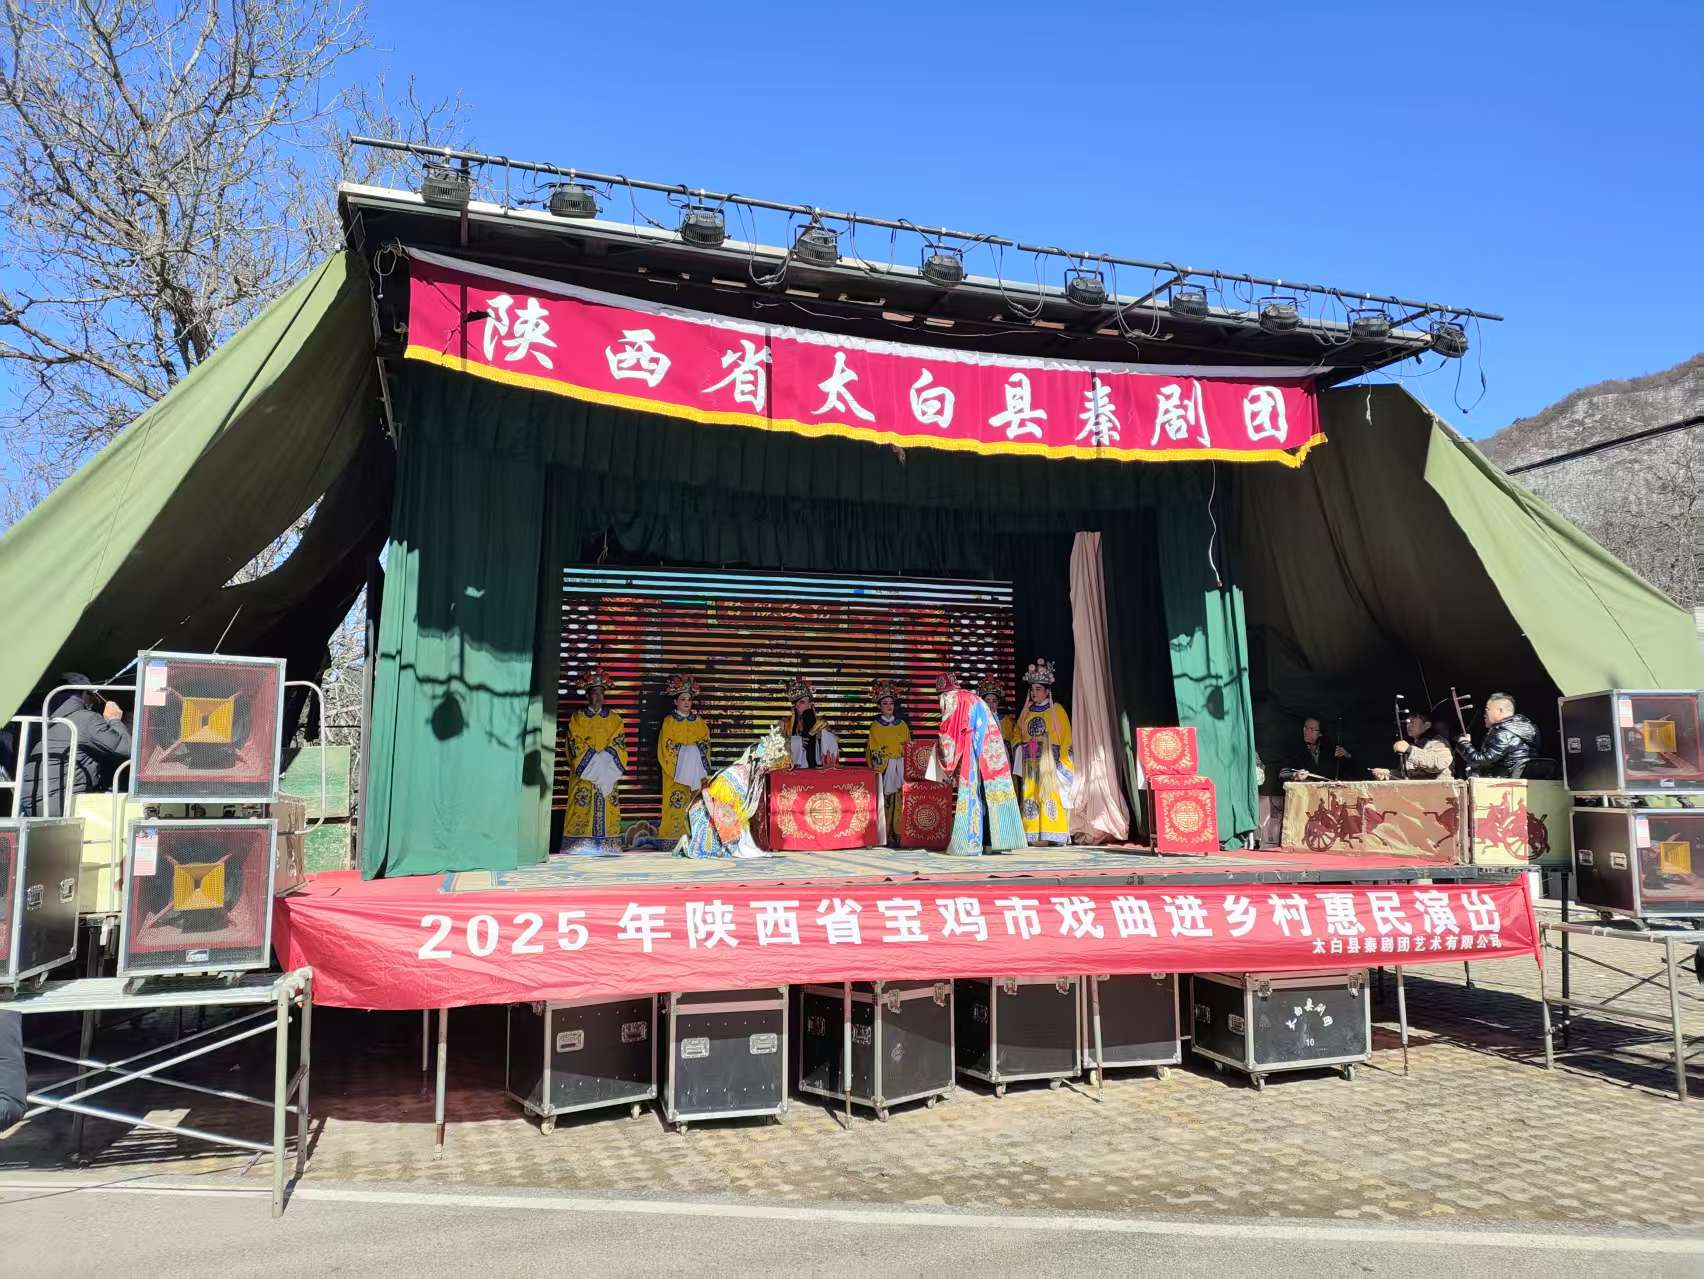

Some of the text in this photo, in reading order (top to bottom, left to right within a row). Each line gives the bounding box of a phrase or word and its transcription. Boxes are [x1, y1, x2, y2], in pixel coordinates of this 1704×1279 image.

[482, 294, 1288, 447] 陕西省太白县秦剧团
[418, 889, 1501, 960] 2025年陕西省宝鸡市戏曲进乡村惠民演出
